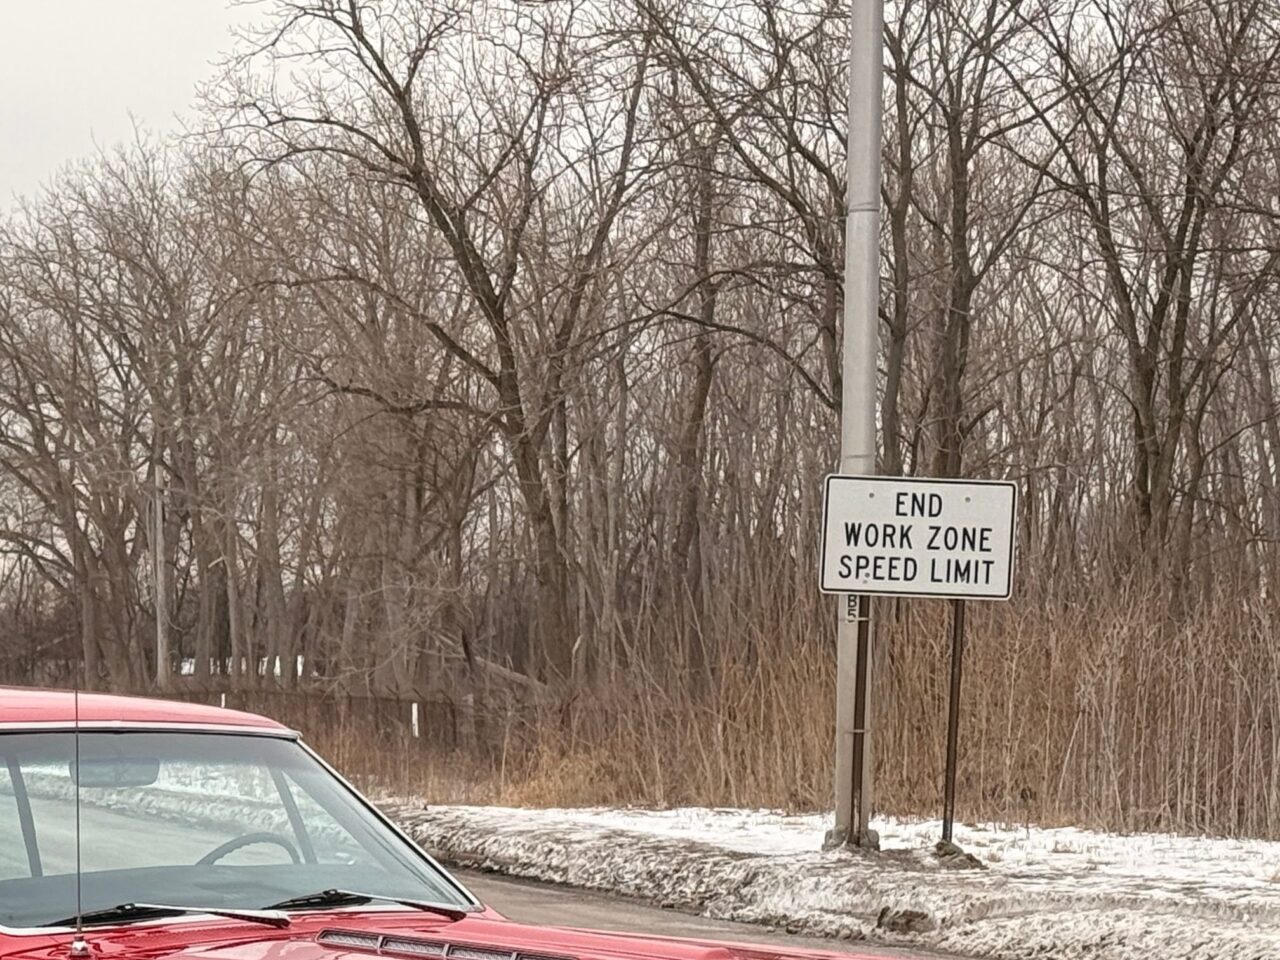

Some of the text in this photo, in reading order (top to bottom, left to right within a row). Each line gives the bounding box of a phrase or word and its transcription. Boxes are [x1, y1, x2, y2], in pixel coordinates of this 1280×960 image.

[895, 492, 943, 518] END
[844, 521, 993, 552] WORK ZONE
[838, 554, 995, 585] SPEED LIMIT
